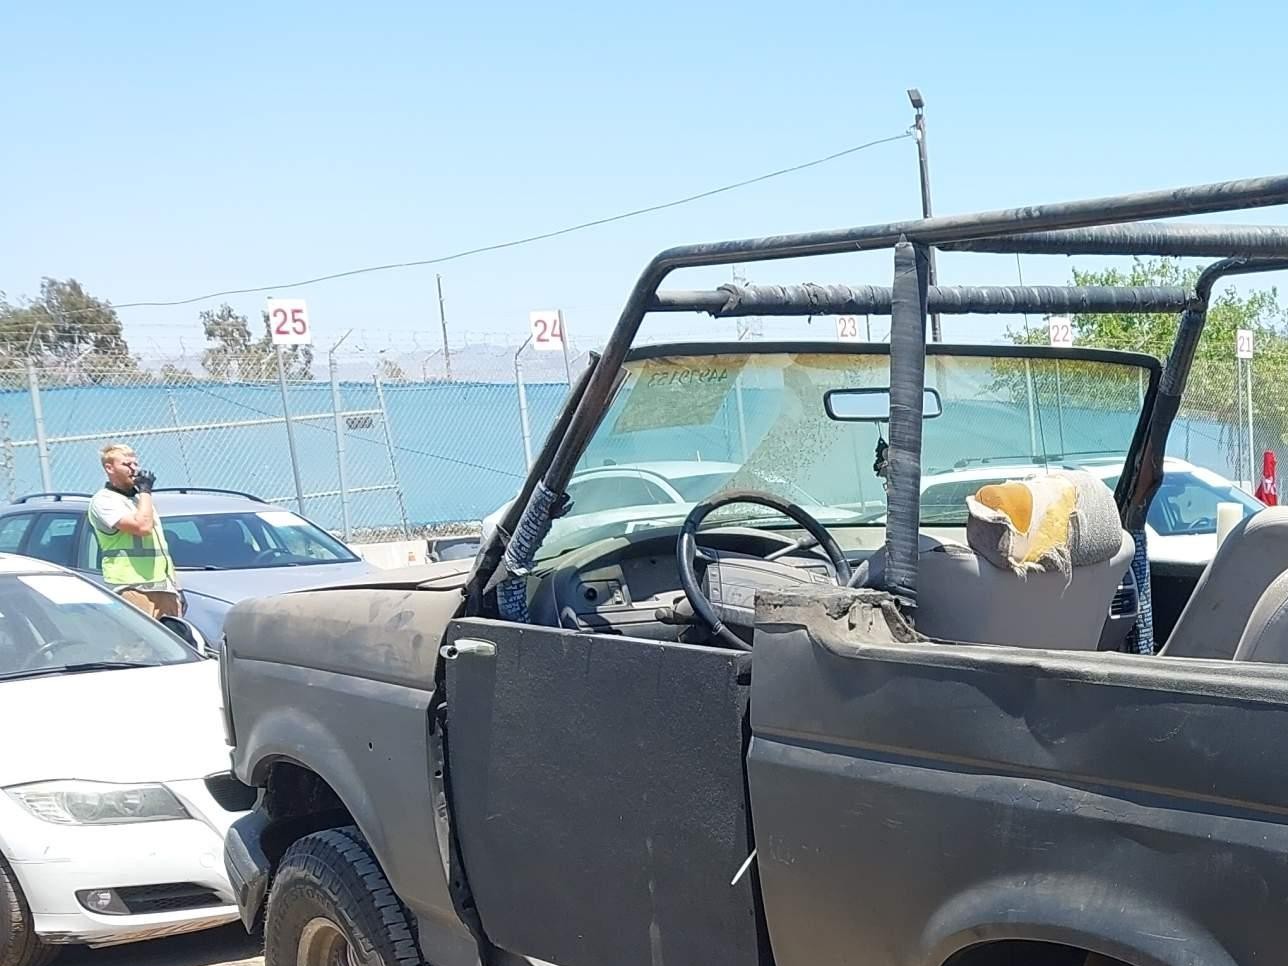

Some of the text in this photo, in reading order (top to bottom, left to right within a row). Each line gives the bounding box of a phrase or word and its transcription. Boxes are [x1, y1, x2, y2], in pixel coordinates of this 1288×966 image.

[273, 308, 307, 335] 25
[534, 319, 563, 342] 24
[839, 317, 857, 337] 23
[1052, 324, 1070, 342] 22
[1239, 335, 1252, 352] 21
